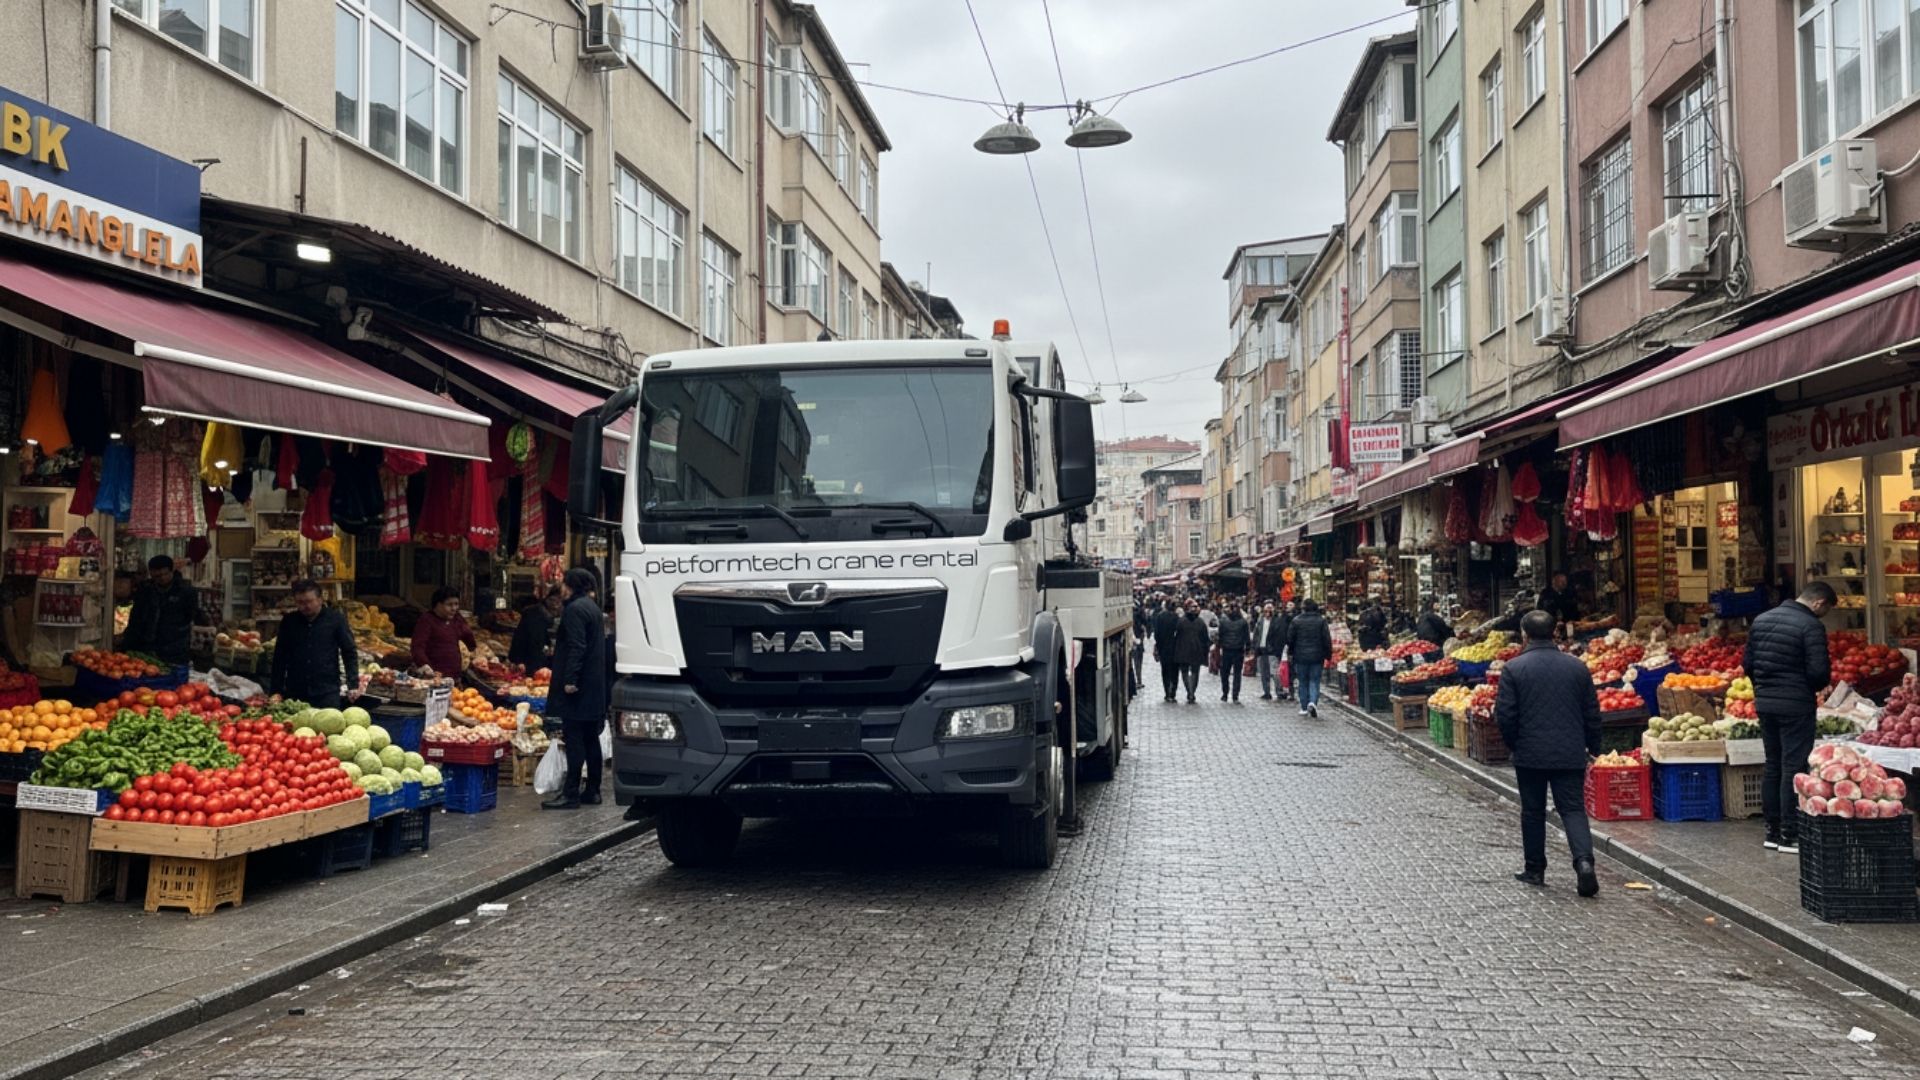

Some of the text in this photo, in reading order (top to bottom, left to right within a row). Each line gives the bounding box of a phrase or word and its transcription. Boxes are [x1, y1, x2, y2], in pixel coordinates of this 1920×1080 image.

[817, 555, 894, 570] crane
[900, 549, 978, 567] rental
[752, 630, 864, 654] MAN
